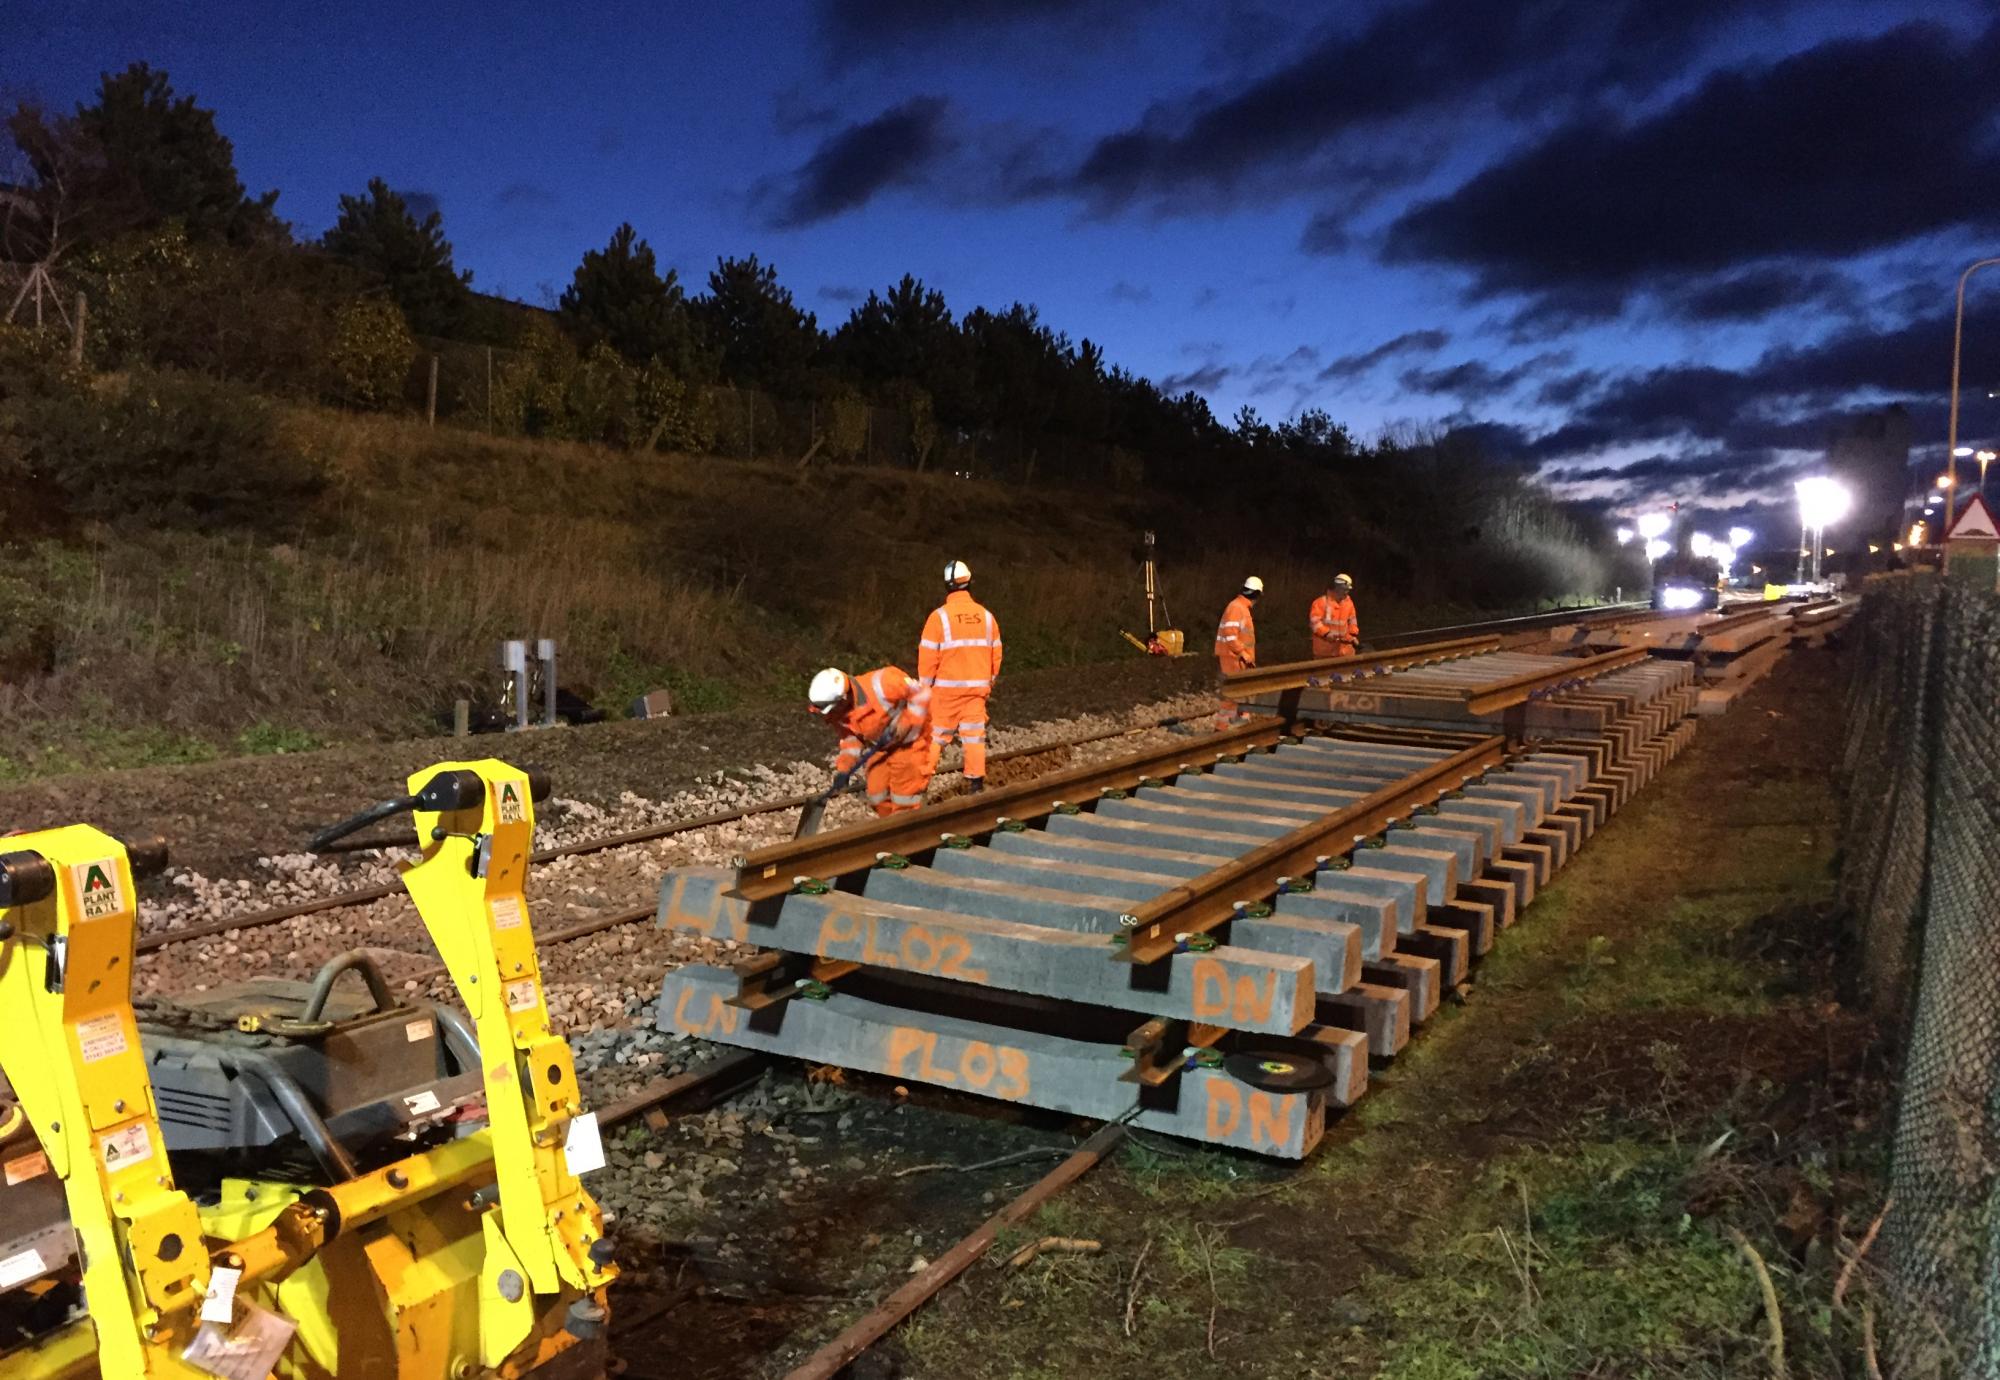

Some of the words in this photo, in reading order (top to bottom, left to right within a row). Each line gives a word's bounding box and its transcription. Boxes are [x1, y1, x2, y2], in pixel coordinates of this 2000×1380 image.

[955, 613, 982, 624] TES
[84, 865, 112, 893] A
[84, 890, 116, 906] PLANT
[86, 902, 119, 918] RAIL
[816, 908, 989, 983] PL02
[673, 985, 737, 1036] LN
[1192, 958, 1277, 1025] DN
[888, 1026, 1030, 1101] PL03
[1205, 1076, 1297, 1146] DN
